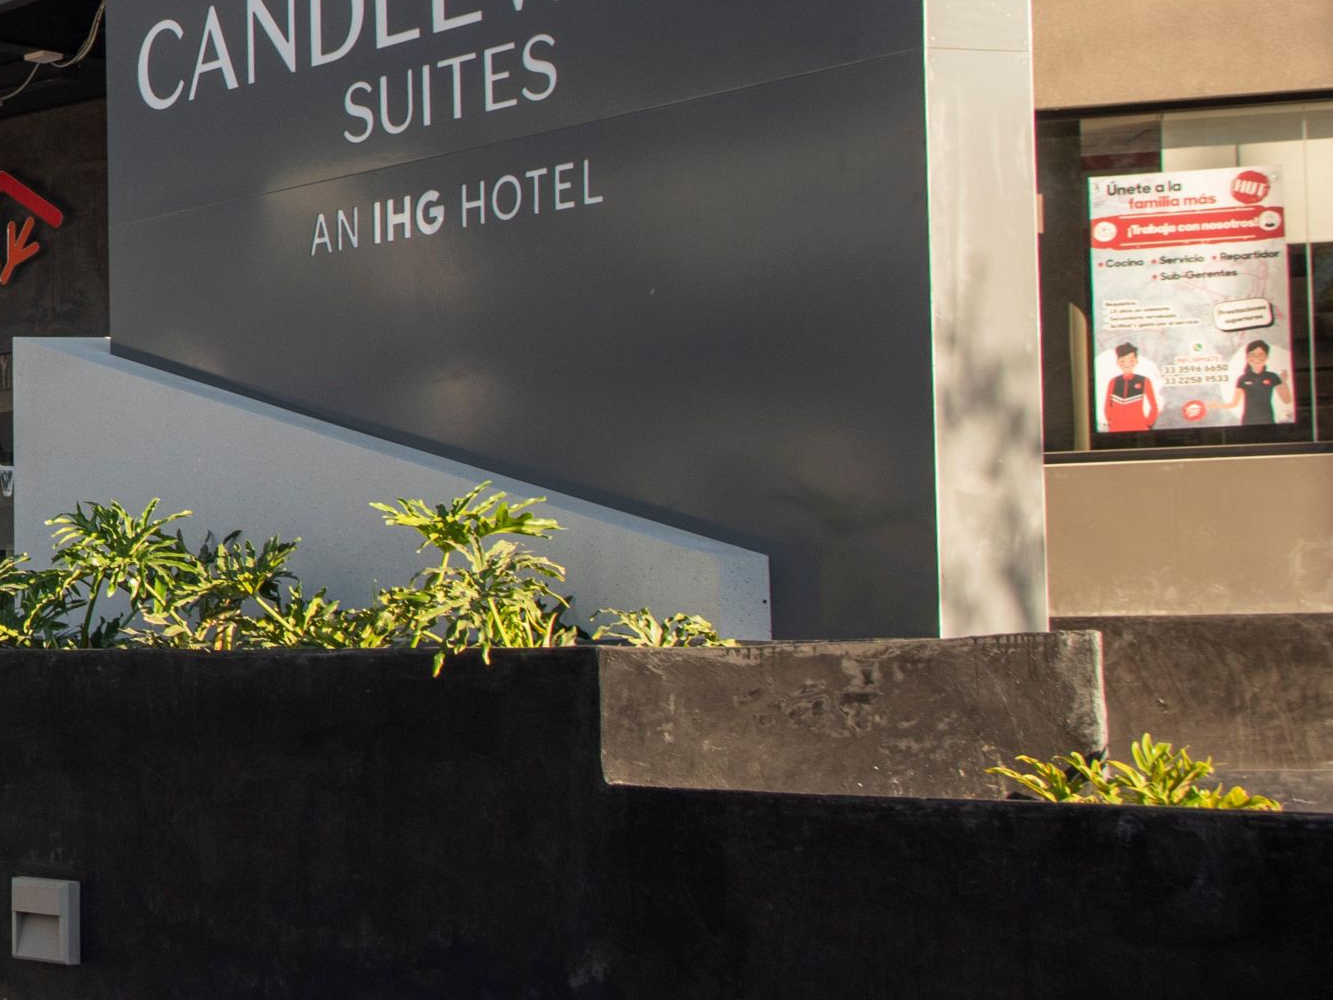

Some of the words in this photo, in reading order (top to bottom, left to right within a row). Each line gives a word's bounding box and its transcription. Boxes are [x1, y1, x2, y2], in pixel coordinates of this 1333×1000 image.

[342, 34, 558, 144] SUITES
[1107, 180, 1151, 196] Únete
[1156, 184, 1165, 193] a
[1167, 180, 1182, 193] la
[310, 209, 359, 256] AN
[372, 190, 446, 245] IHG
[461, 159, 604, 228] HOTEL
[1128, 196, 1179, 210] familia
[1184, 194, 1216, 206] más
[1177, 223, 1200, 233] con
[1159, 253, 1205, 265] Servicio
[1220, 249, 1280, 263] Repartidor
[1160, 269, 1238, 281] Sub-Gerentes
